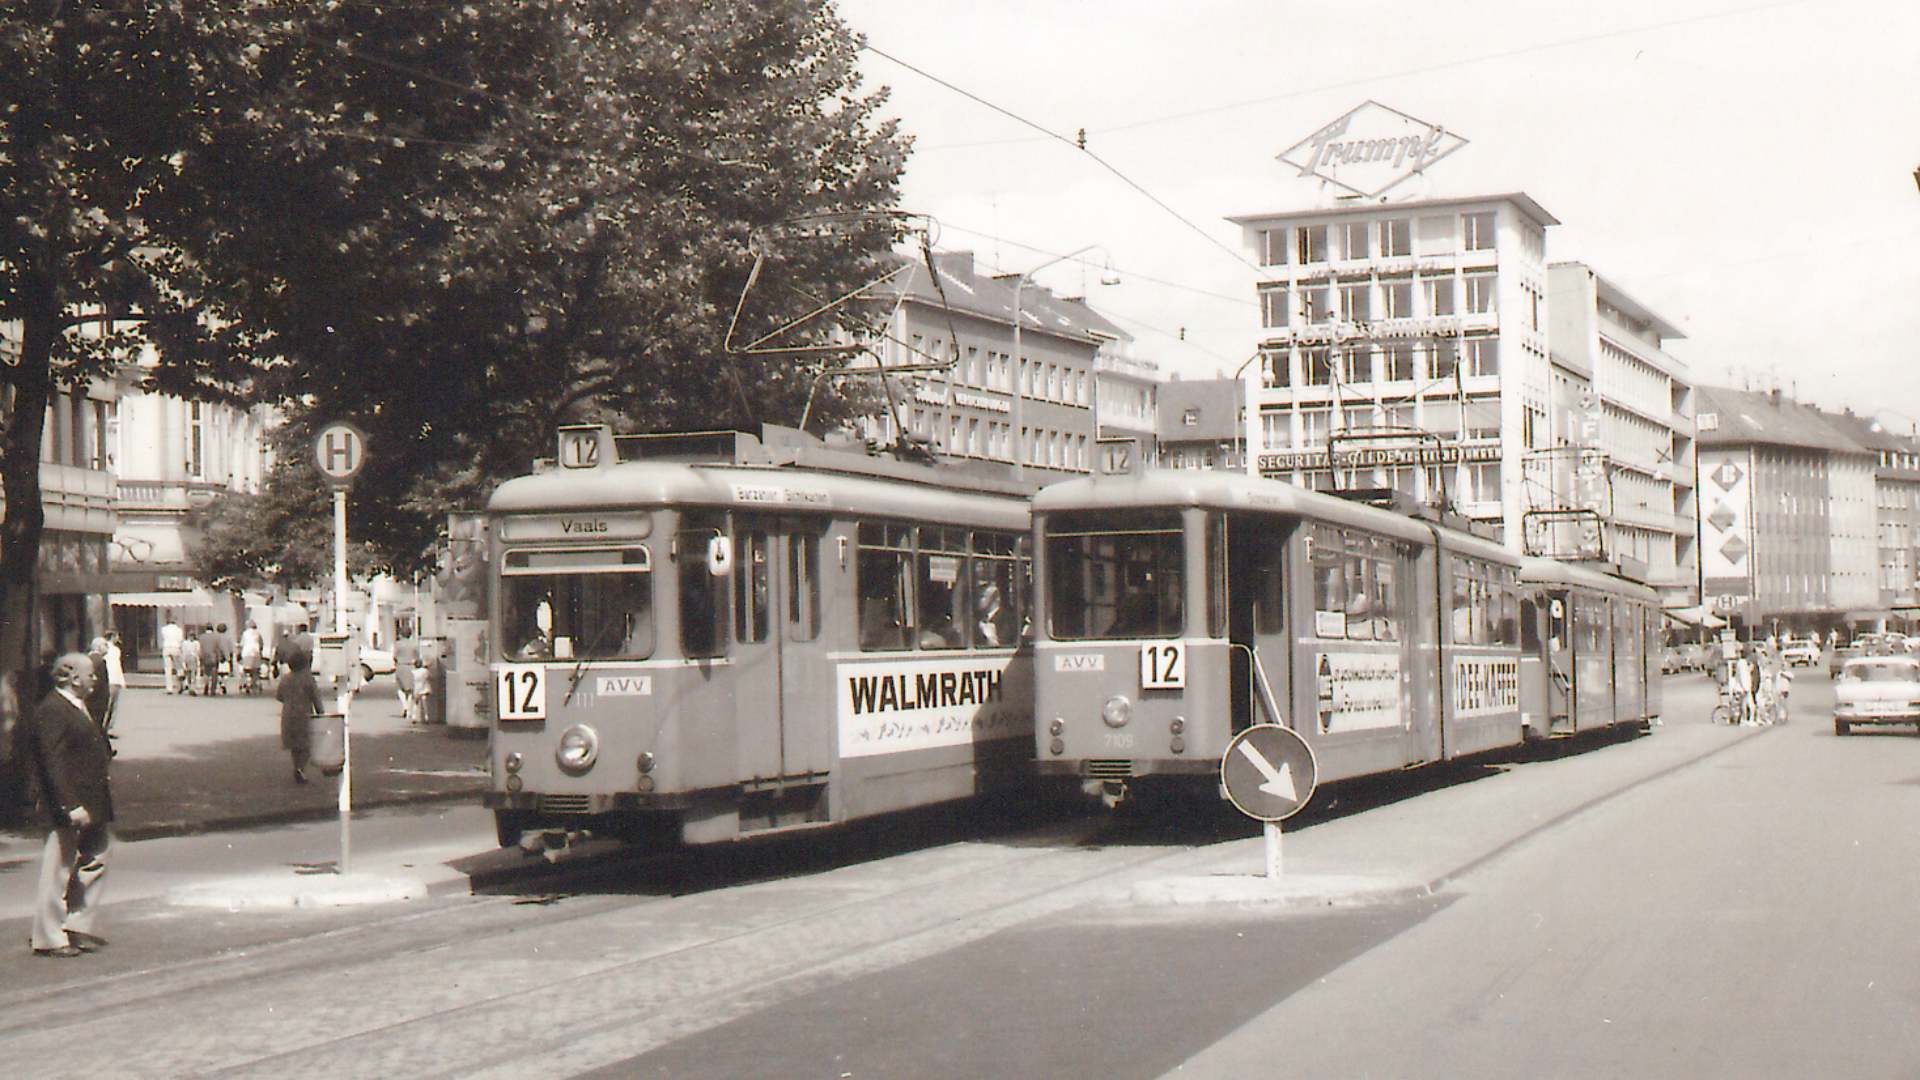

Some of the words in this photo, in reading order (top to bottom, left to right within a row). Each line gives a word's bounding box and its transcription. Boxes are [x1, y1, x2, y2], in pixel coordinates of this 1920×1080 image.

[1297, 115, 1444, 177] Trumpf
[326, 433, 352, 470] H
[572, 436, 597, 464] 12
[1105, 446, 1130, 470] 12
[561, 518, 608, 533] Vaals
[1721, 597, 1733, 608] H
[1062, 655, 1098, 668] AVV
[1148, 646, 1179, 683] 12
[504, 671, 539, 713] 12
[605, 680, 644, 692] AVV
[849, 669, 1003, 716] WALMRATH
[1455, 663, 1517, 711] IDEE-KAFFEE
